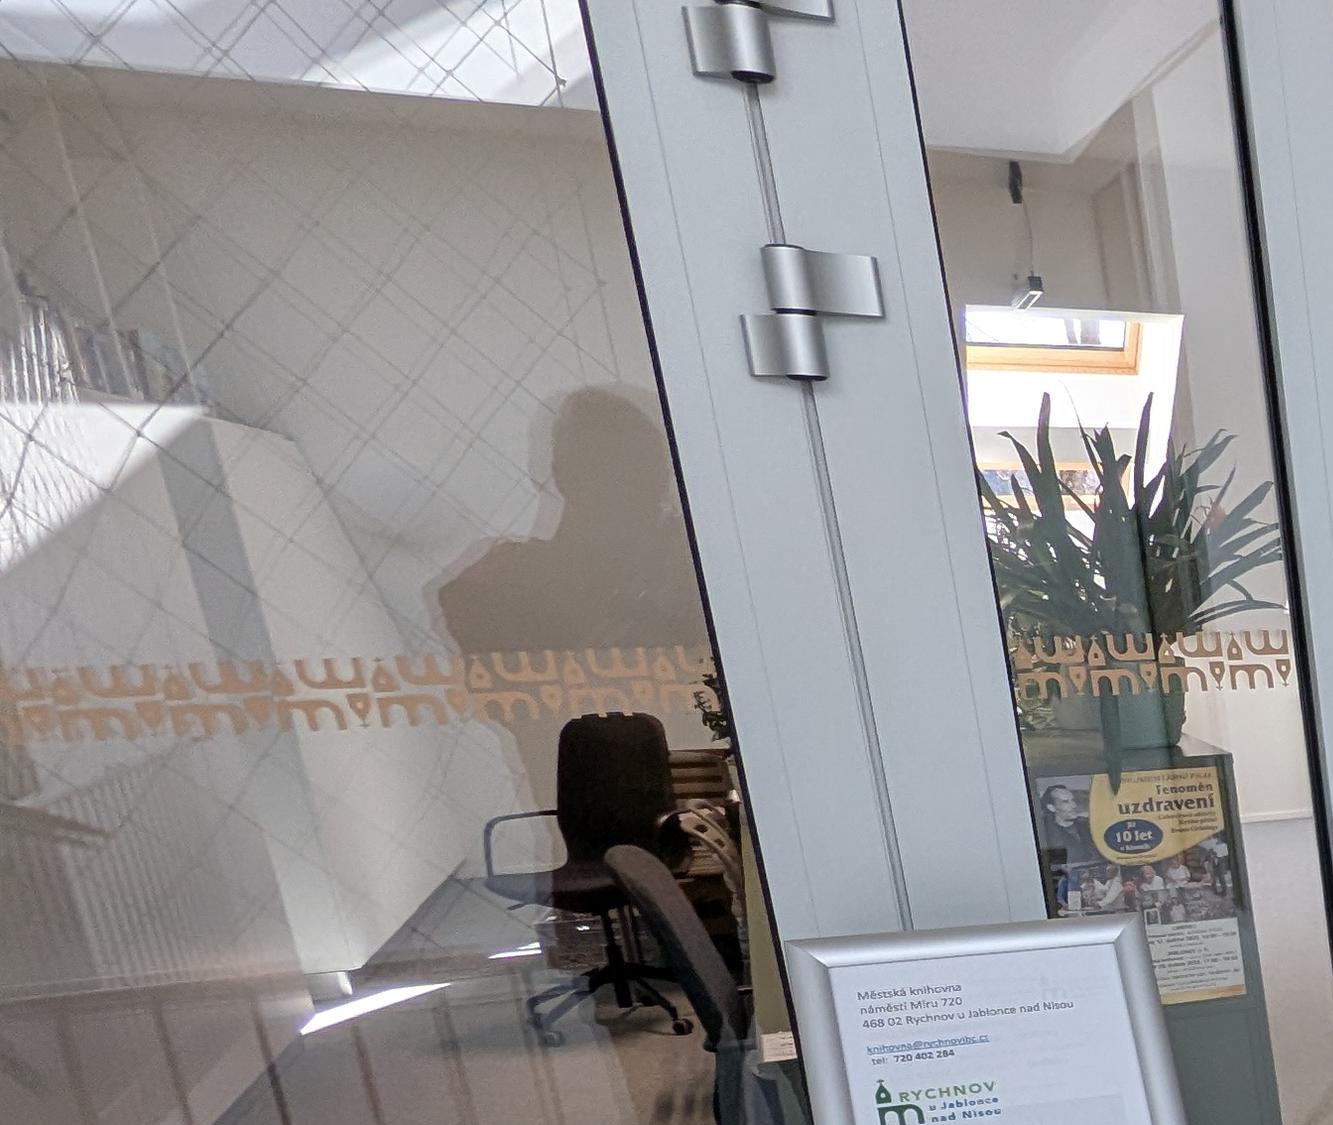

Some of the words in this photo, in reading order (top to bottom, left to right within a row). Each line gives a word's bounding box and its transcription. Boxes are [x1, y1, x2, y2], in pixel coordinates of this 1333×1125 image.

[1118, 793, 1215, 815] uzdravení
[1115, 832, 1132, 843] 10
[857, 986, 907, 1001] Městská
[910, 984, 962, 997] knihovna
[860, 1001, 908, 1015] náměstí
[941, 997, 963, 1008] 720
[862, 1018, 885, 1029] 468
[887, 1016, 903, 1028] 02
[906, 1012, 955, 1027] Rychnov
[957, 1012, 966, 1020] u
[968, 1006, 1017, 1020] Jablonce
[1019, 1003, 1041, 1014] nad
[1043, 1000, 1075, 1012] Nisou
[871, 1057, 889, 1067] tel:
[893, 1053, 913, 1064] 720
[915, 1051, 935, 1061] 402
[899, 1080, 997, 1104] RYCHNOV
[929, 1103, 937, 1112] u
[941, 1096, 999, 1111] Jablonce
[931, 1112, 957, 1124] nad
[962, 1107, 1002, 1120] Nisou
